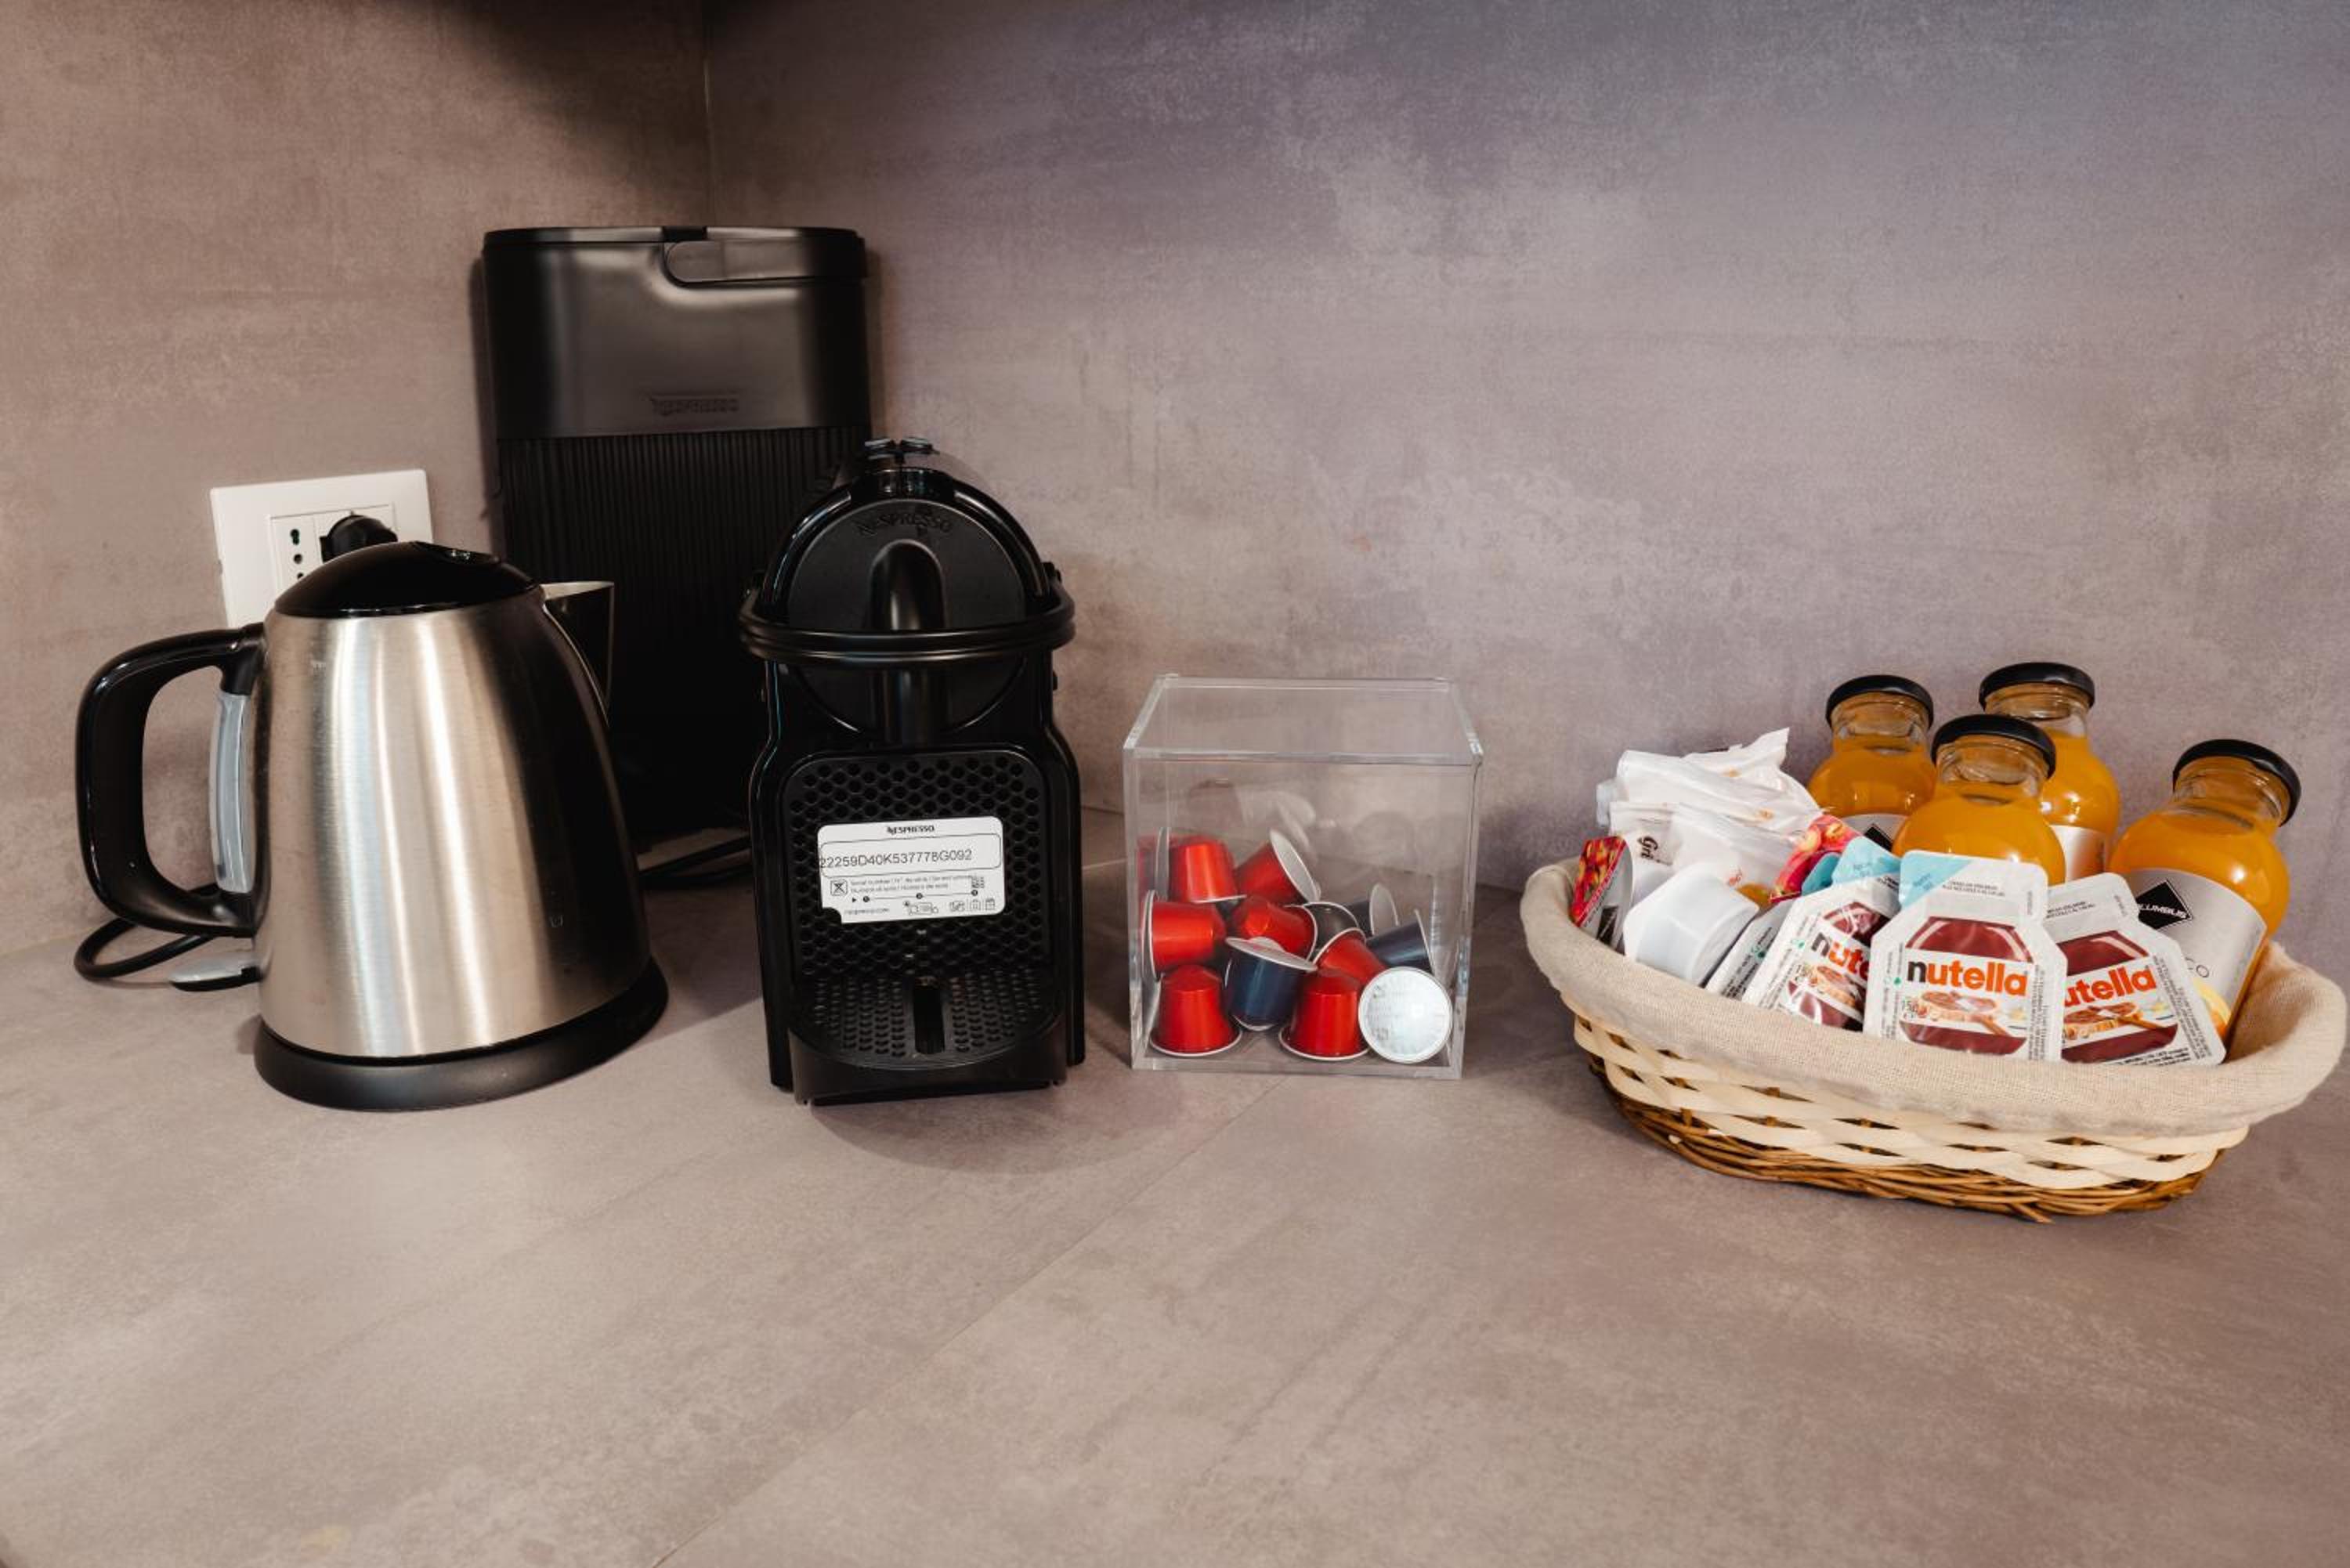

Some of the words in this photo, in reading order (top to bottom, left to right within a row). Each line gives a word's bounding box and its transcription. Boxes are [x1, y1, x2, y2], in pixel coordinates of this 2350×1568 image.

[886, 825, 935, 835] NESPRESSO
[2138, 903, 2187, 919] LUMBUS
[1907, 959, 2027, 996] nutella
